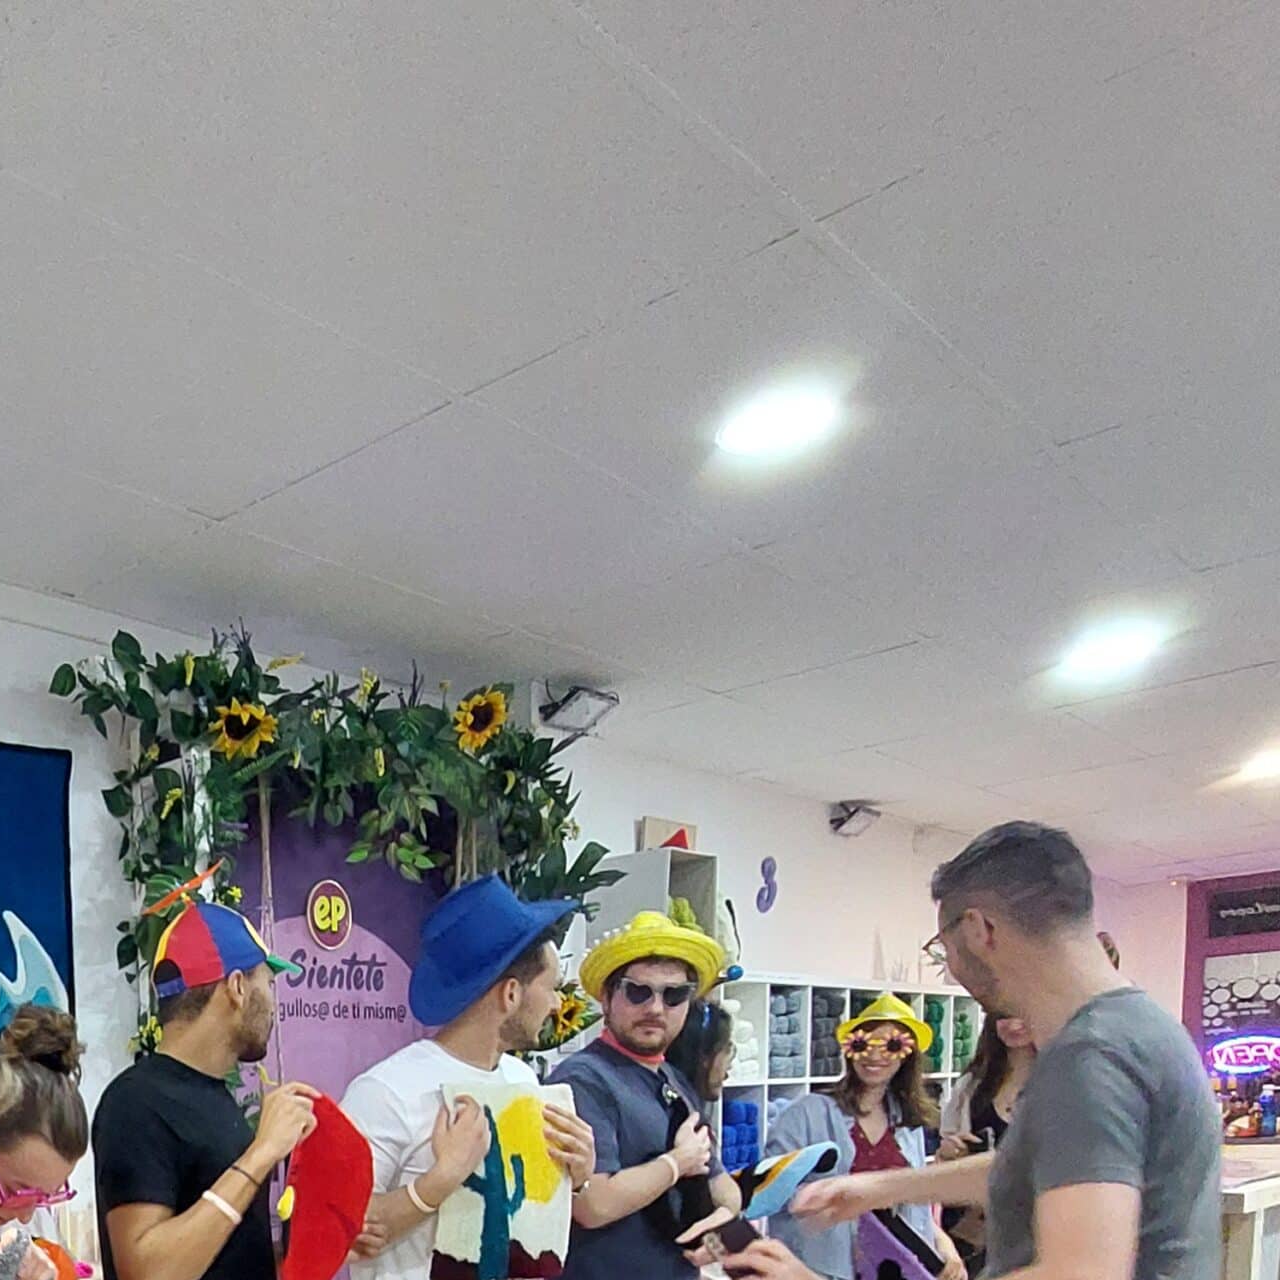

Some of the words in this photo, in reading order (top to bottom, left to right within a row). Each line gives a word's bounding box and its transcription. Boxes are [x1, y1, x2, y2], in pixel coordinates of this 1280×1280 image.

[313, 895, 346, 932] ep
[286, 949, 387, 992] Sientete
[279, 998, 330, 1021] gullos@
[333, 1000, 349, 1015] de
[352, 1001, 360, 1019] ti
[364, 1003, 407, 1023] mism@
